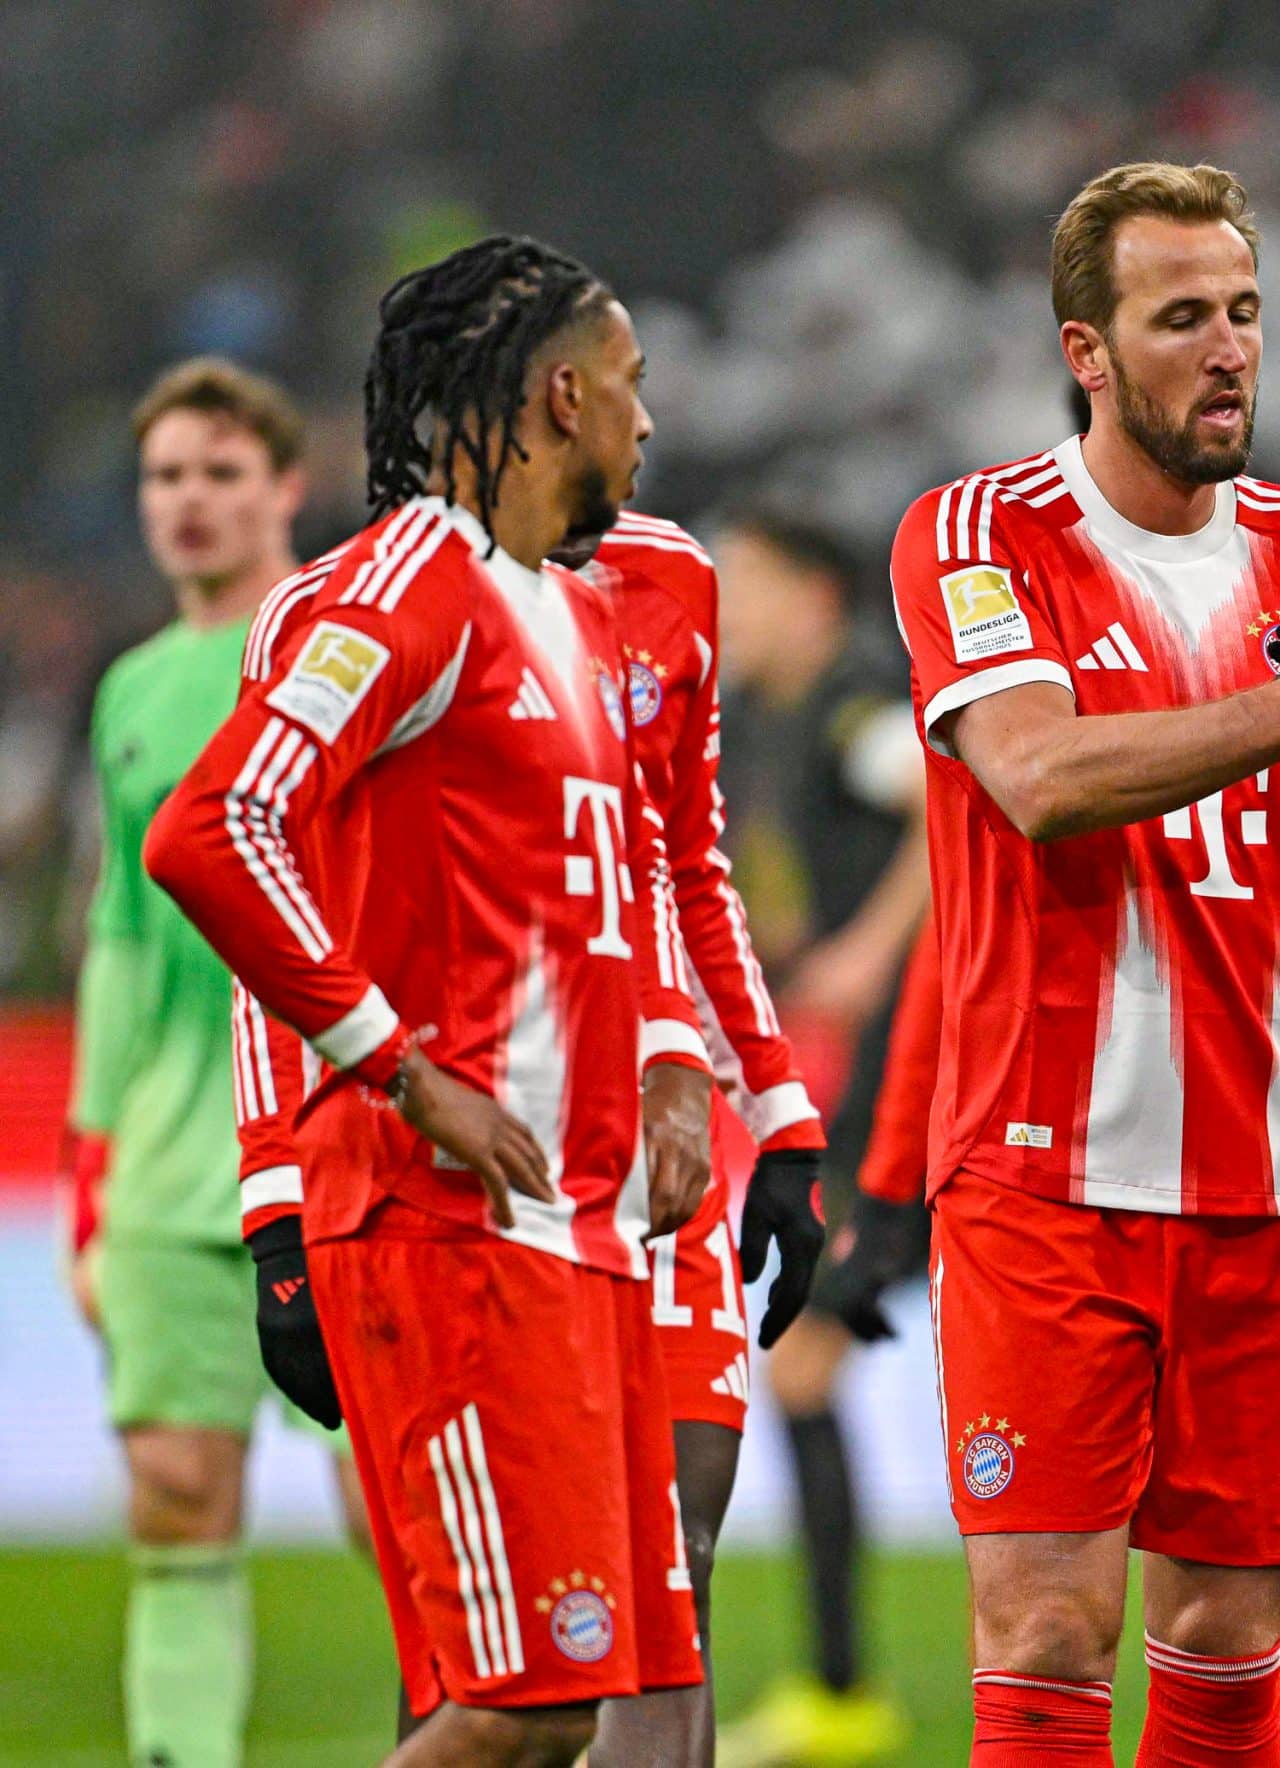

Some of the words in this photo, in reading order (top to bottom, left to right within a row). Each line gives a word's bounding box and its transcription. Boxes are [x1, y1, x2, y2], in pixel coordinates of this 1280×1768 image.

[959, 613, 1020, 637] BUNDESLIGA
[563, 775, 635, 960] T
[645, 1220, 747, 1340] 11
[967, 1450, 976, 1464] FC
[975, 1438, 1009, 1460] BAYERN
